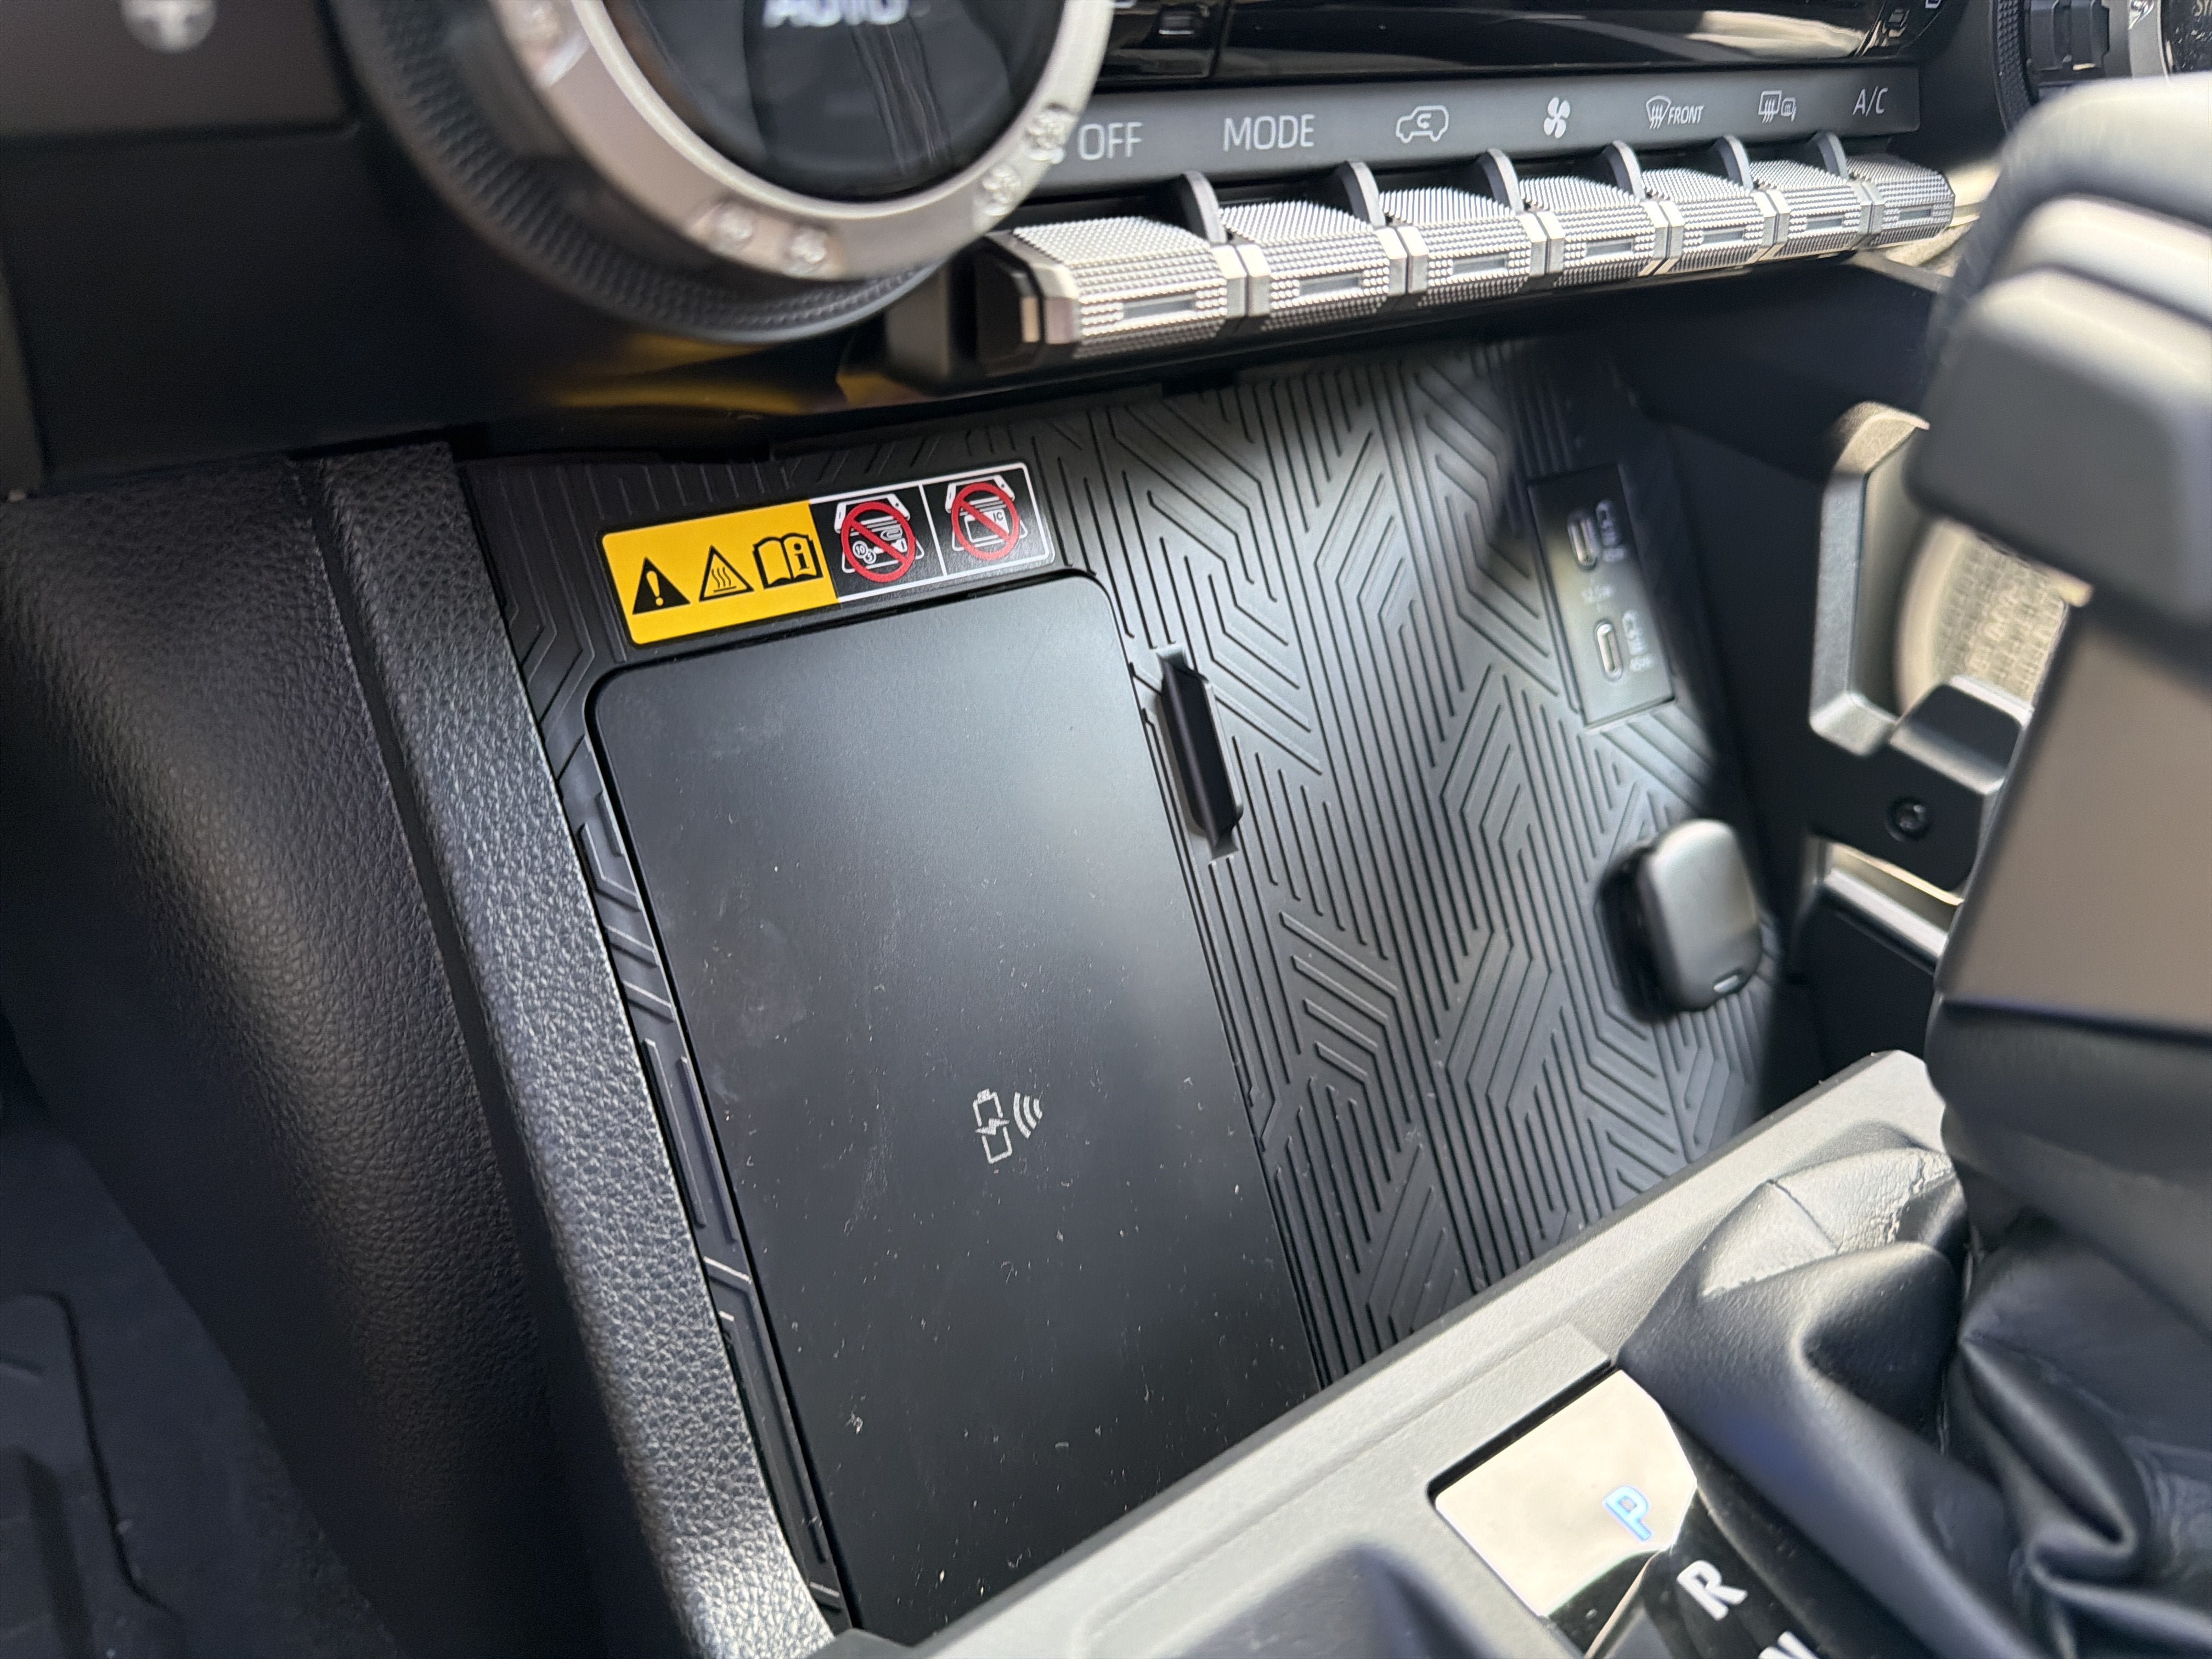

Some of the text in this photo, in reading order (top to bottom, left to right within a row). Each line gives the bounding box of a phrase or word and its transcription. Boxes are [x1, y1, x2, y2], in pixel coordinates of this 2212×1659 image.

[1667, 105, 1704, 126] FRONT
[1853, 86, 1888, 116] A/C
[1077, 121, 1143, 161] OFF
[1223, 114, 1315, 152] MODE
[992, 511, 1003, 522] IC
[854, 545, 866, 555] 10
[1605, 1485, 1652, 1541] P
[1677, 1559, 1748, 1621] R
